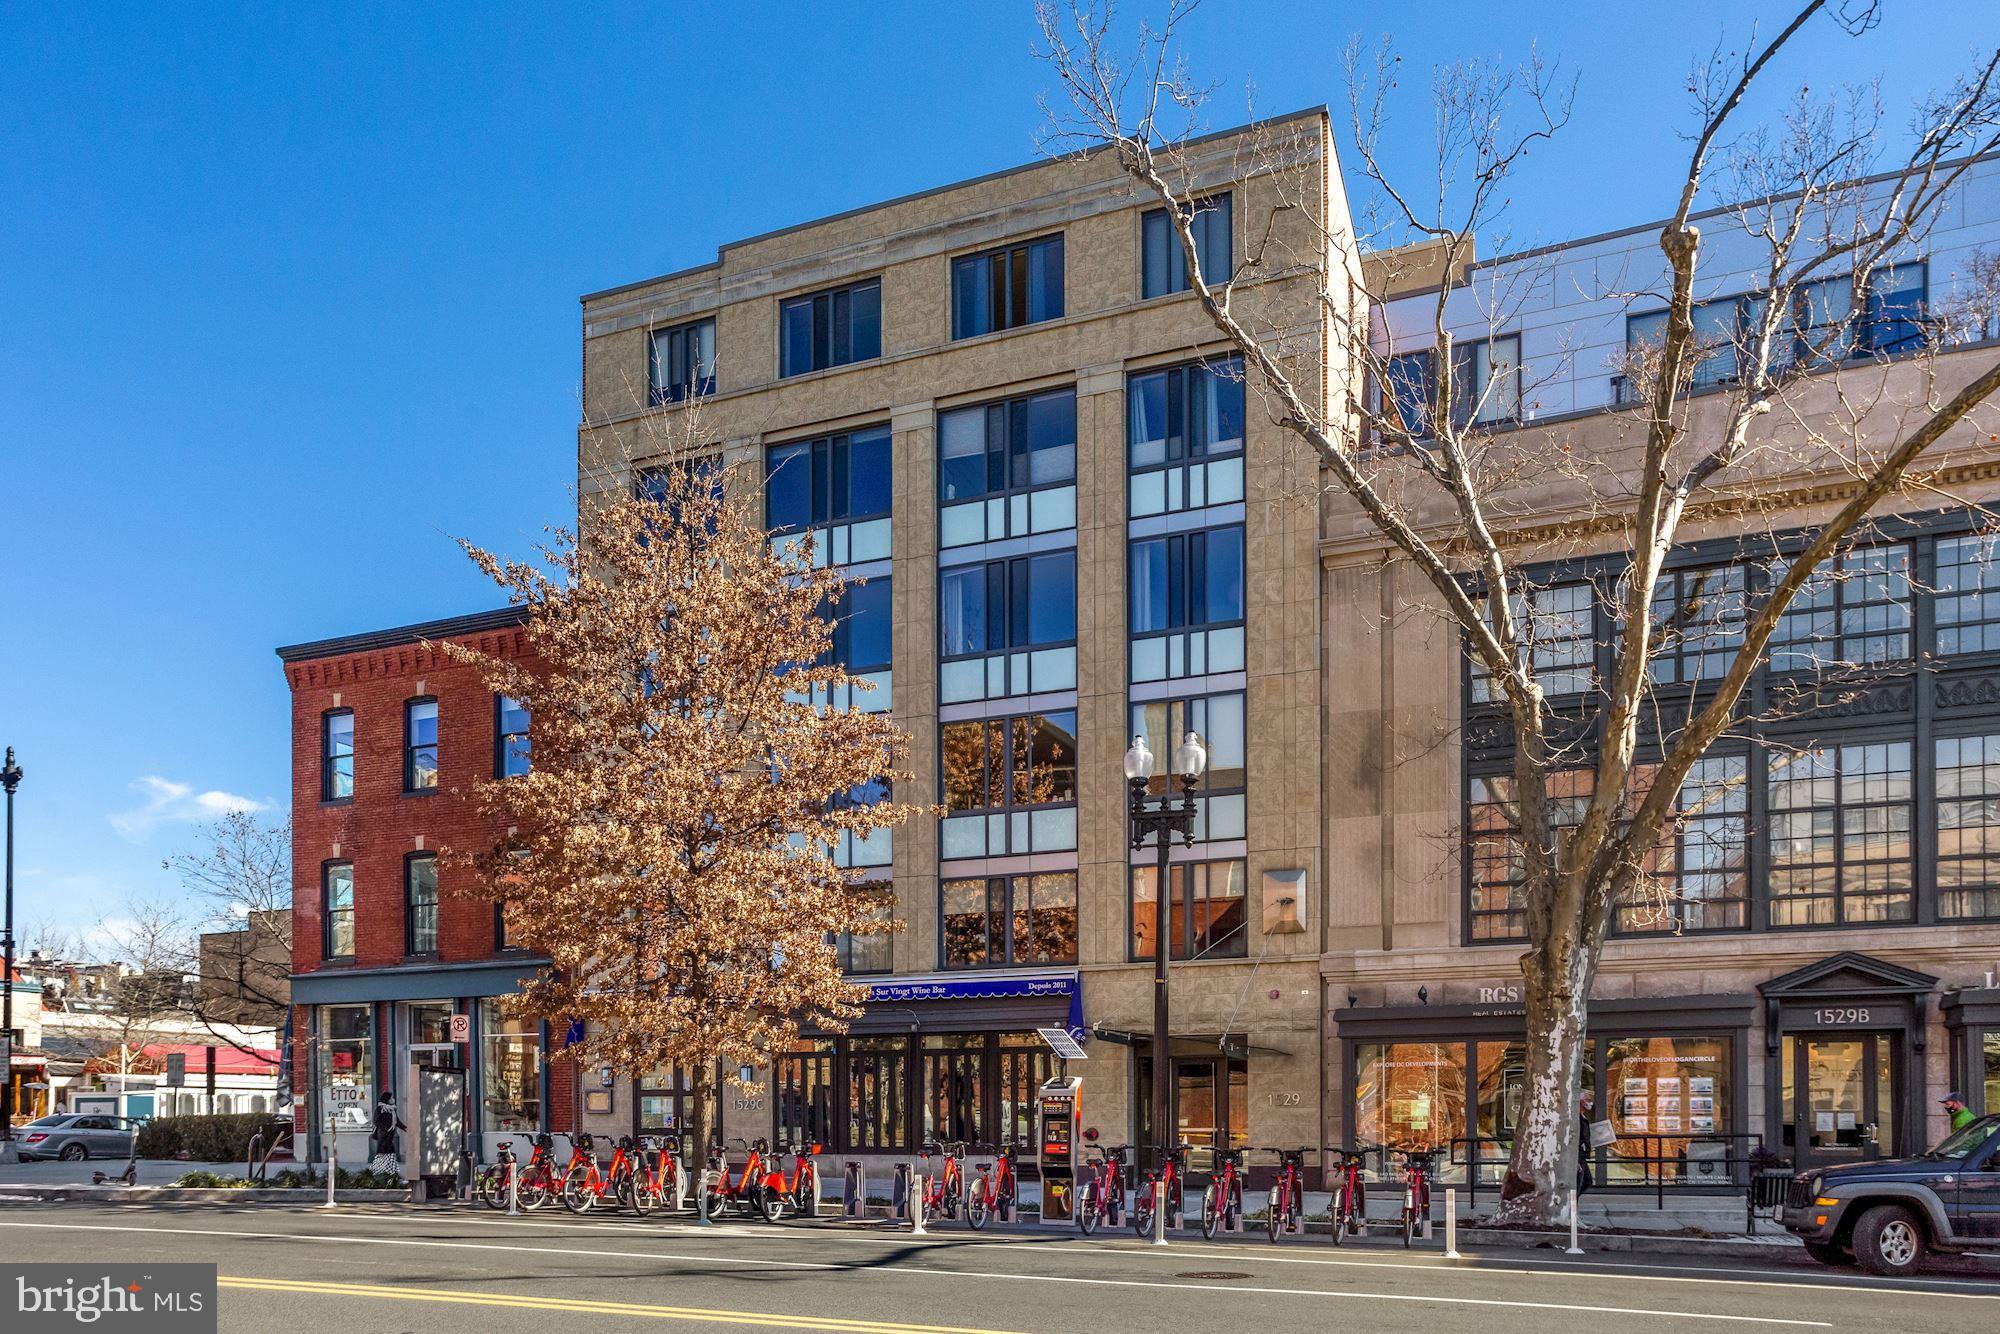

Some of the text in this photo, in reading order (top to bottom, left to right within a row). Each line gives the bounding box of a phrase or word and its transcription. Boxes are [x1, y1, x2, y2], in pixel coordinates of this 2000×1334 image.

[876, 988, 889, 996] Sur
[890, 987, 910, 997] Vingt
[911, 986, 930, 995] Wine
[932, 985, 946, 994] Bar
[1028, 981, 1066, 991] Depuis 2011
[1479, 987, 1518, 1003] RGS
[1814, 1008, 1870, 1024] 1529B
[732, 1099, 763, 1110] 1529C
